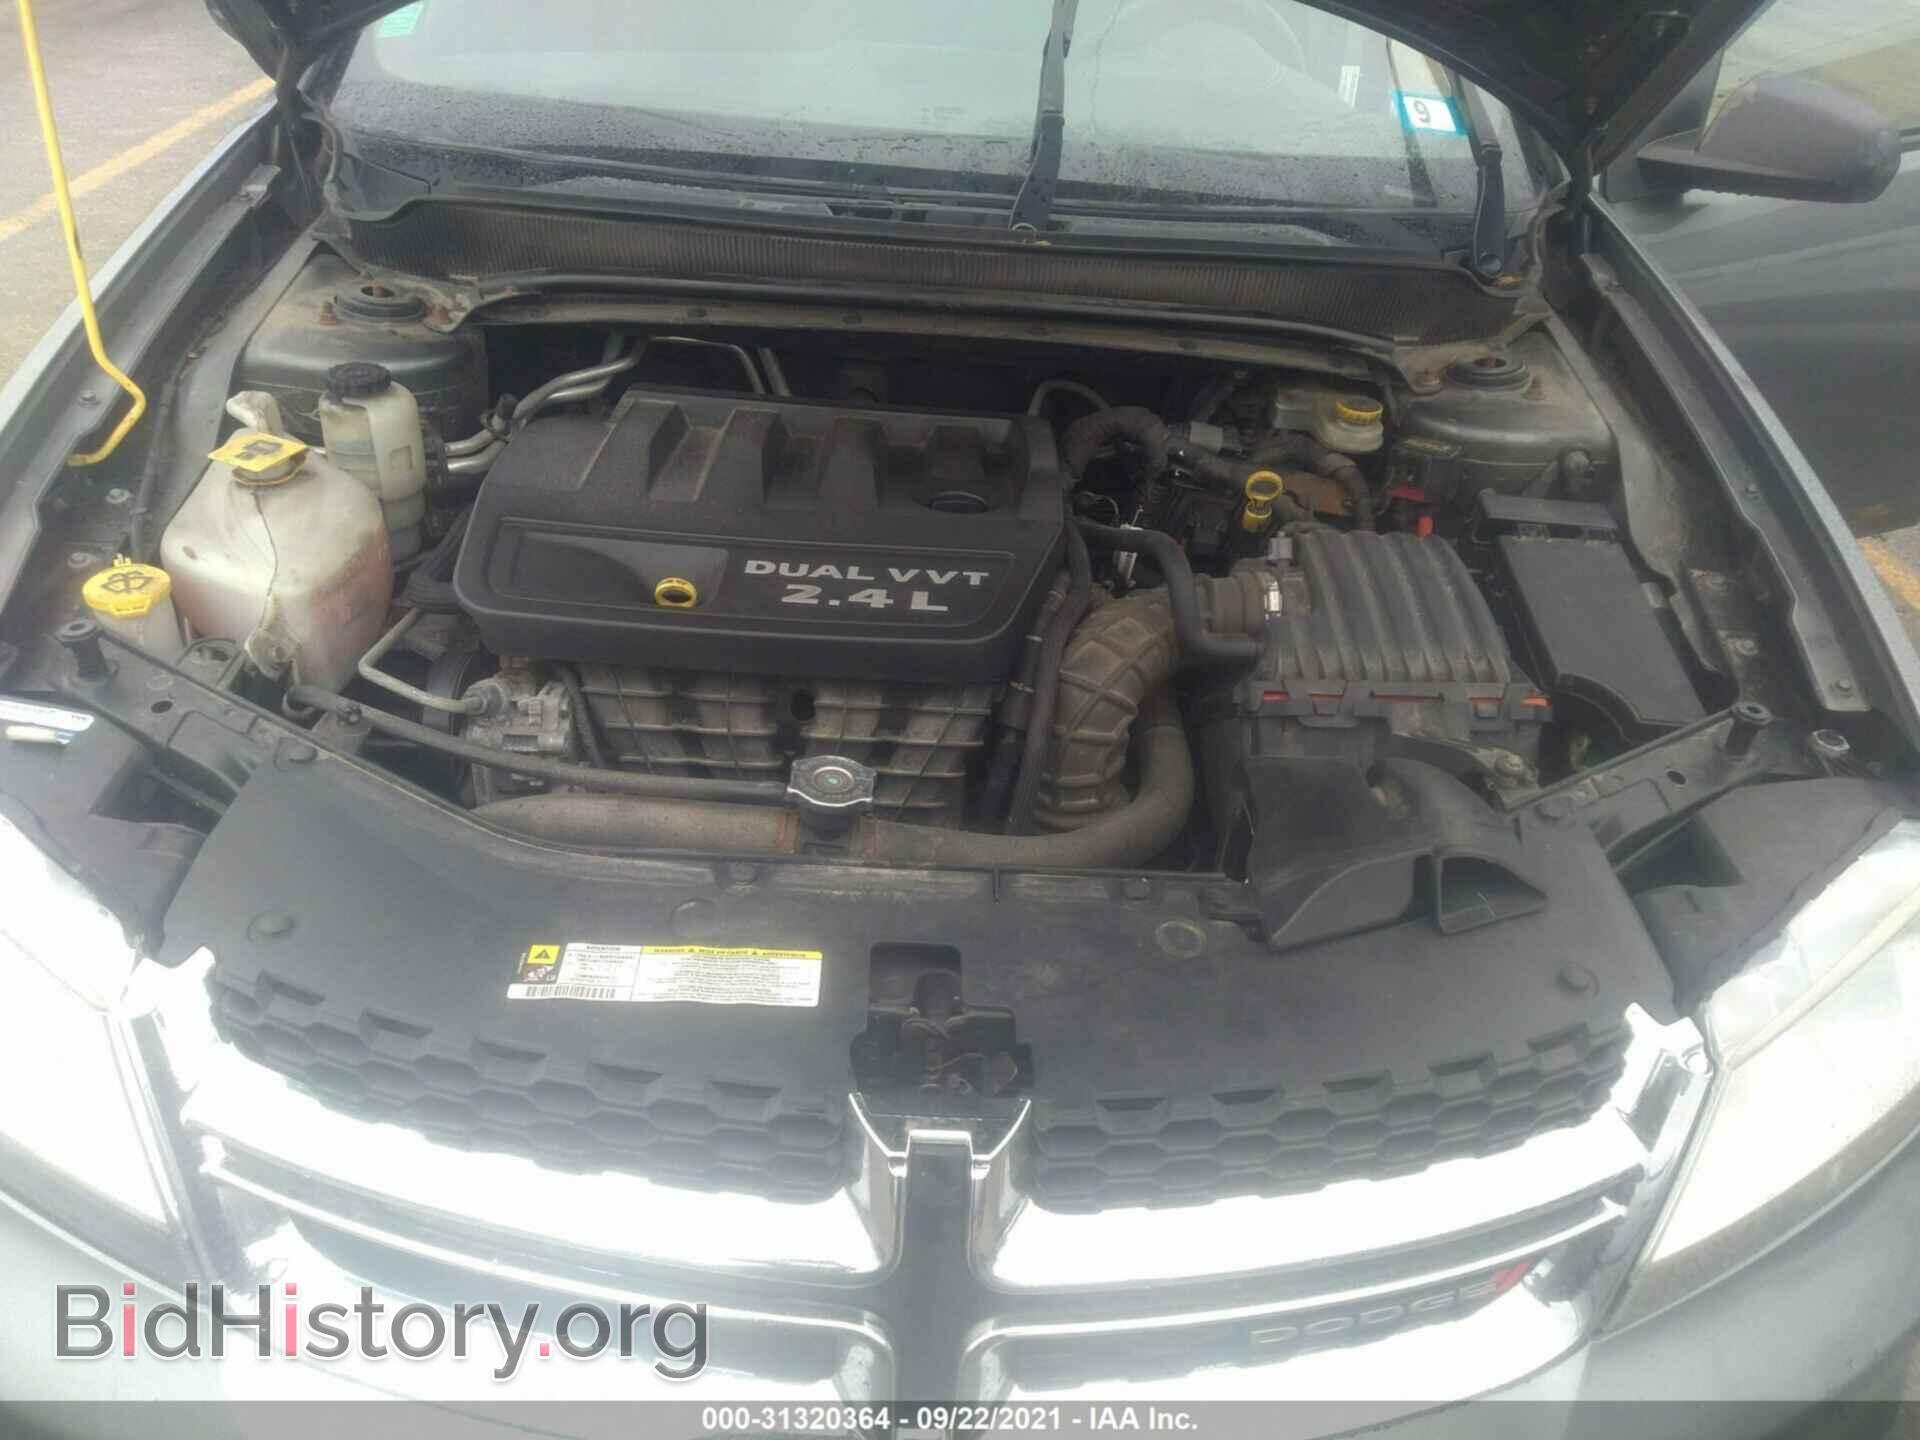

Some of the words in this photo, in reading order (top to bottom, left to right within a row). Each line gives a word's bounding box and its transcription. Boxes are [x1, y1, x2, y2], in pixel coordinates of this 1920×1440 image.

[744, 559, 875, 581] DUAL
[887, 567, 990, 586] VVT
[1250, 1279, 1499, 1345] DODGE
